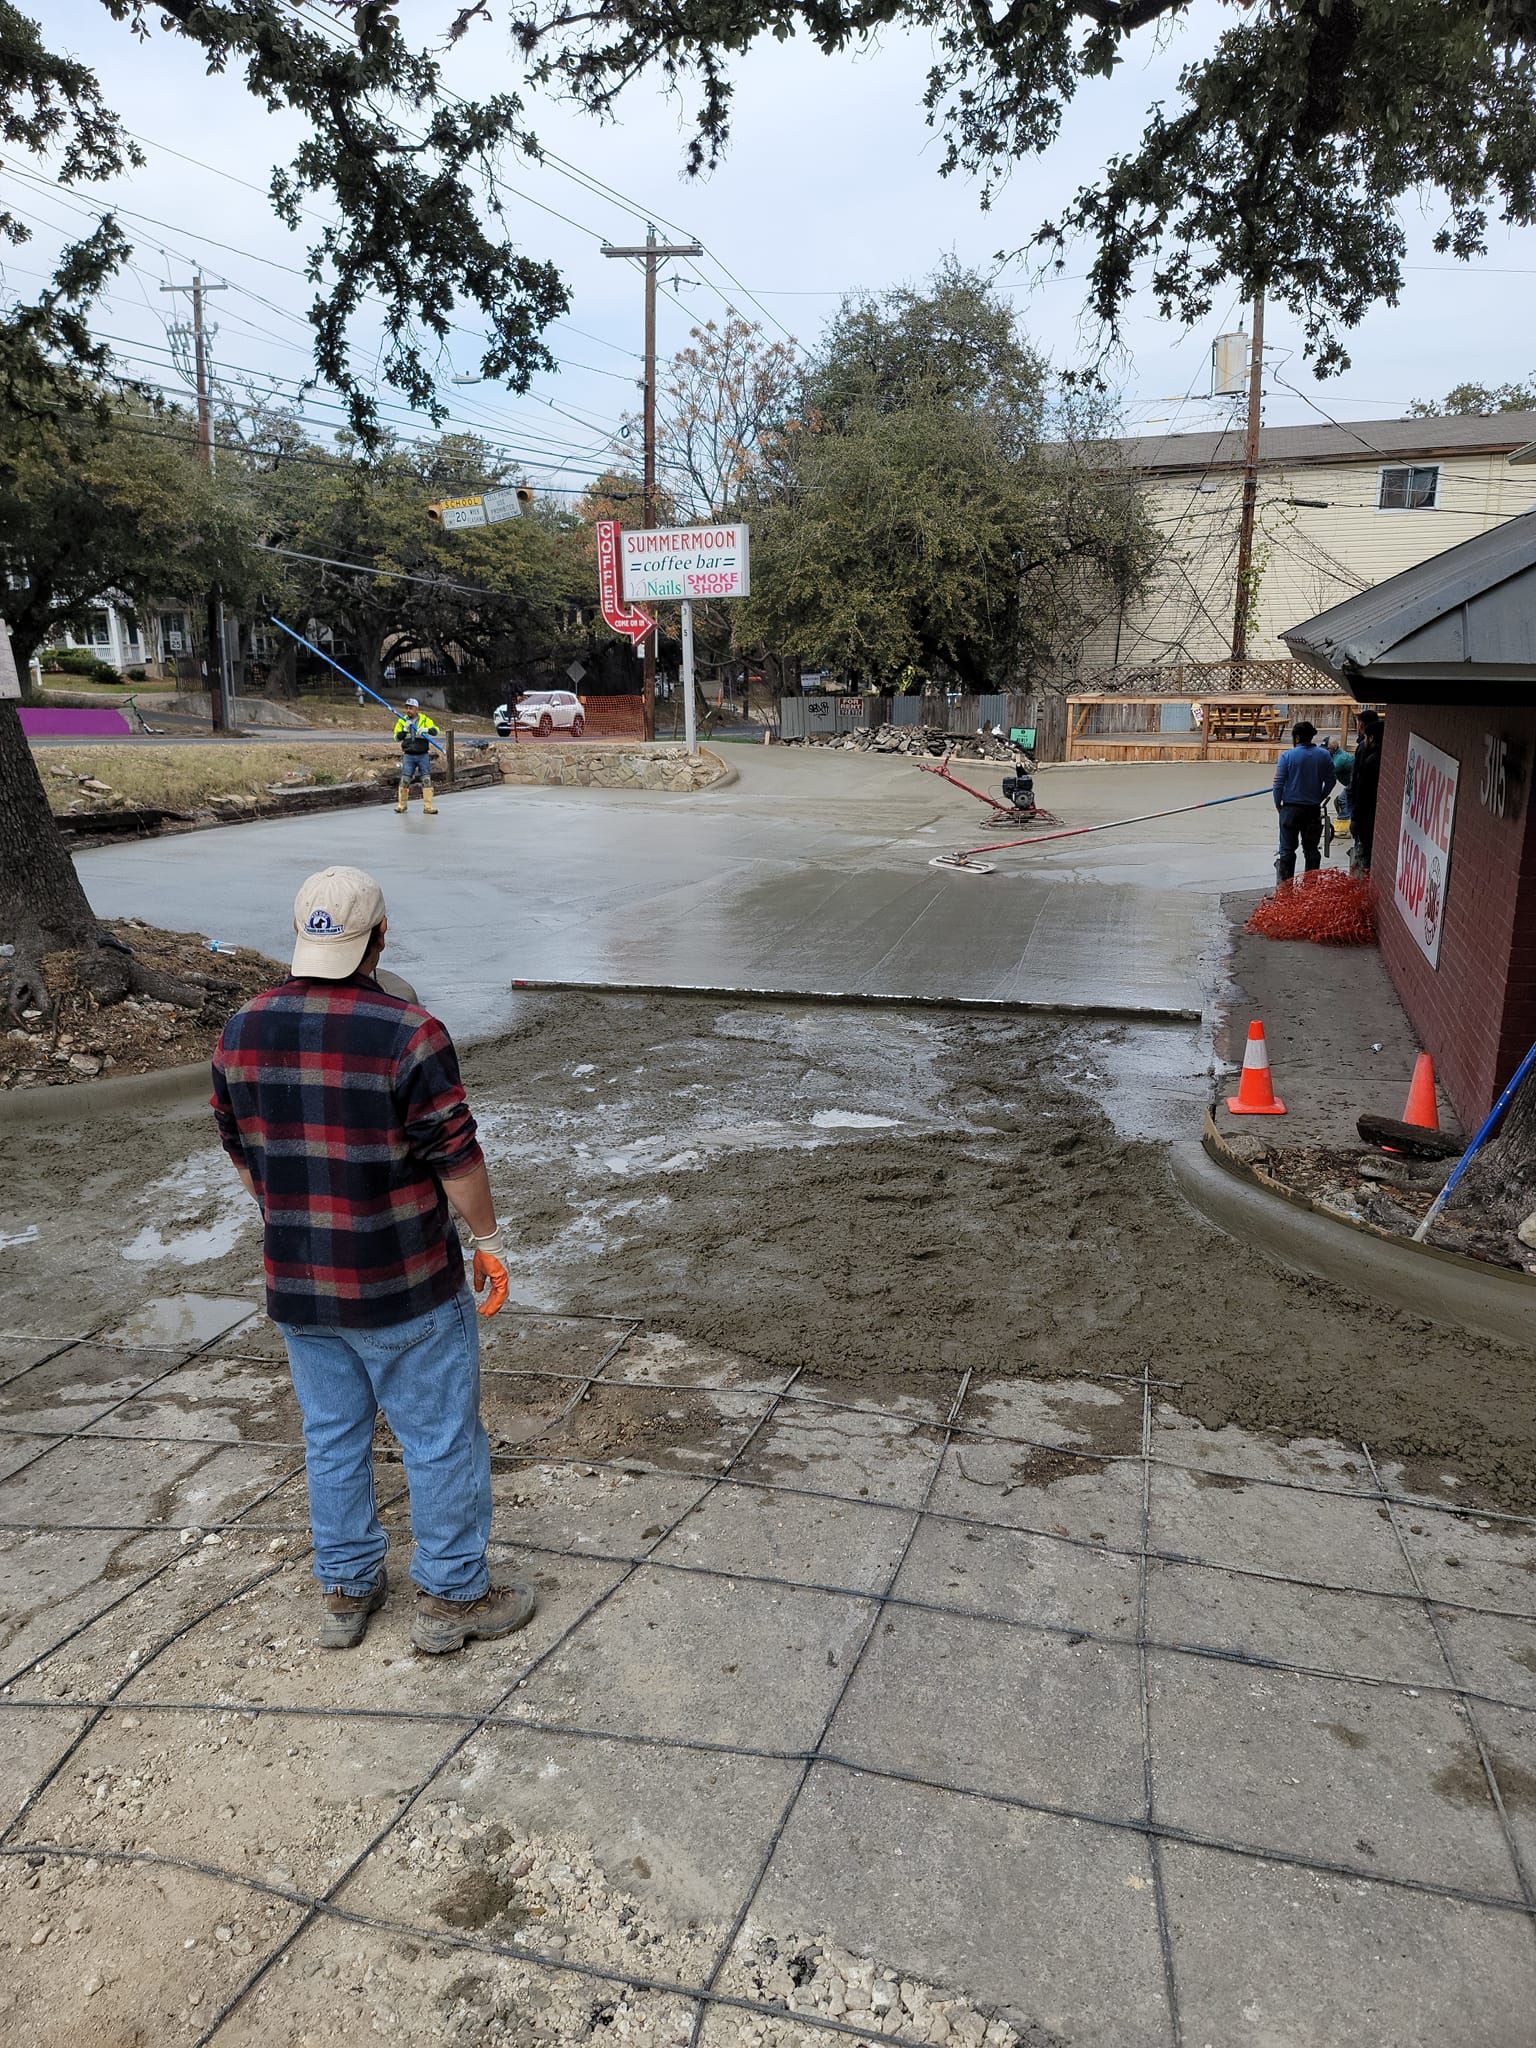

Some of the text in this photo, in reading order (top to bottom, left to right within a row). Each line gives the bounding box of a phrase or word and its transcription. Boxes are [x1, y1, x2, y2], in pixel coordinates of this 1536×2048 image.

[445, 498, 479, 508] SCHOOL
[455, 511, 467, 522] 20
[628, 531, 736, 552] SUMMERMOON
[599, 524, 614, 613] COFFEE
[643, 554, 722, 572] coffee bar
[687, 573, 739, 584] SMOKE
[647, 580, 682, 596] Nails
[694, 584, 733, 594] SHOP
[1410, 754, 1455, 854] SMOKE
[1398, 830, 1427, 917] SHOP
